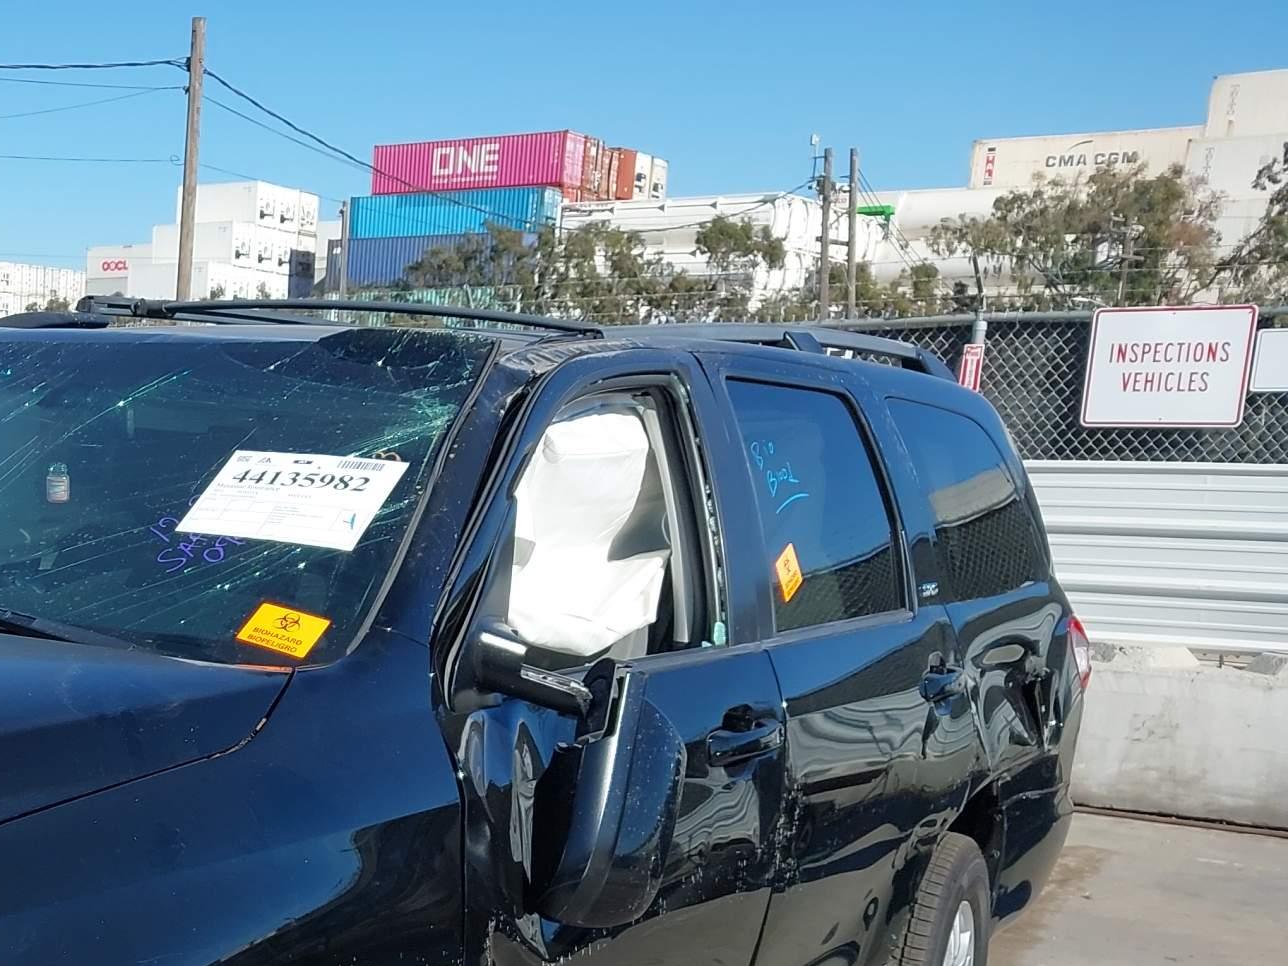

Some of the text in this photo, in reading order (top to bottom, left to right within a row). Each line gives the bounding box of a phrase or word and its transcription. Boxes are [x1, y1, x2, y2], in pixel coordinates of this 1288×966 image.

[432, 143, 500, 176] ONE
[1045, 151, 1140, 168] CMA CGM
[102, 260, 129, 271] OOCL
[1108, 341, 1232, 363] INSPECTIONS
[1121, 371, 1211, 392] VEHICLES
[232, 468, 372, 492] 44135982
[247, 634, 298, 653] BIOPELIGRO
[252, 626, 304, 646] BIOHAZARD
